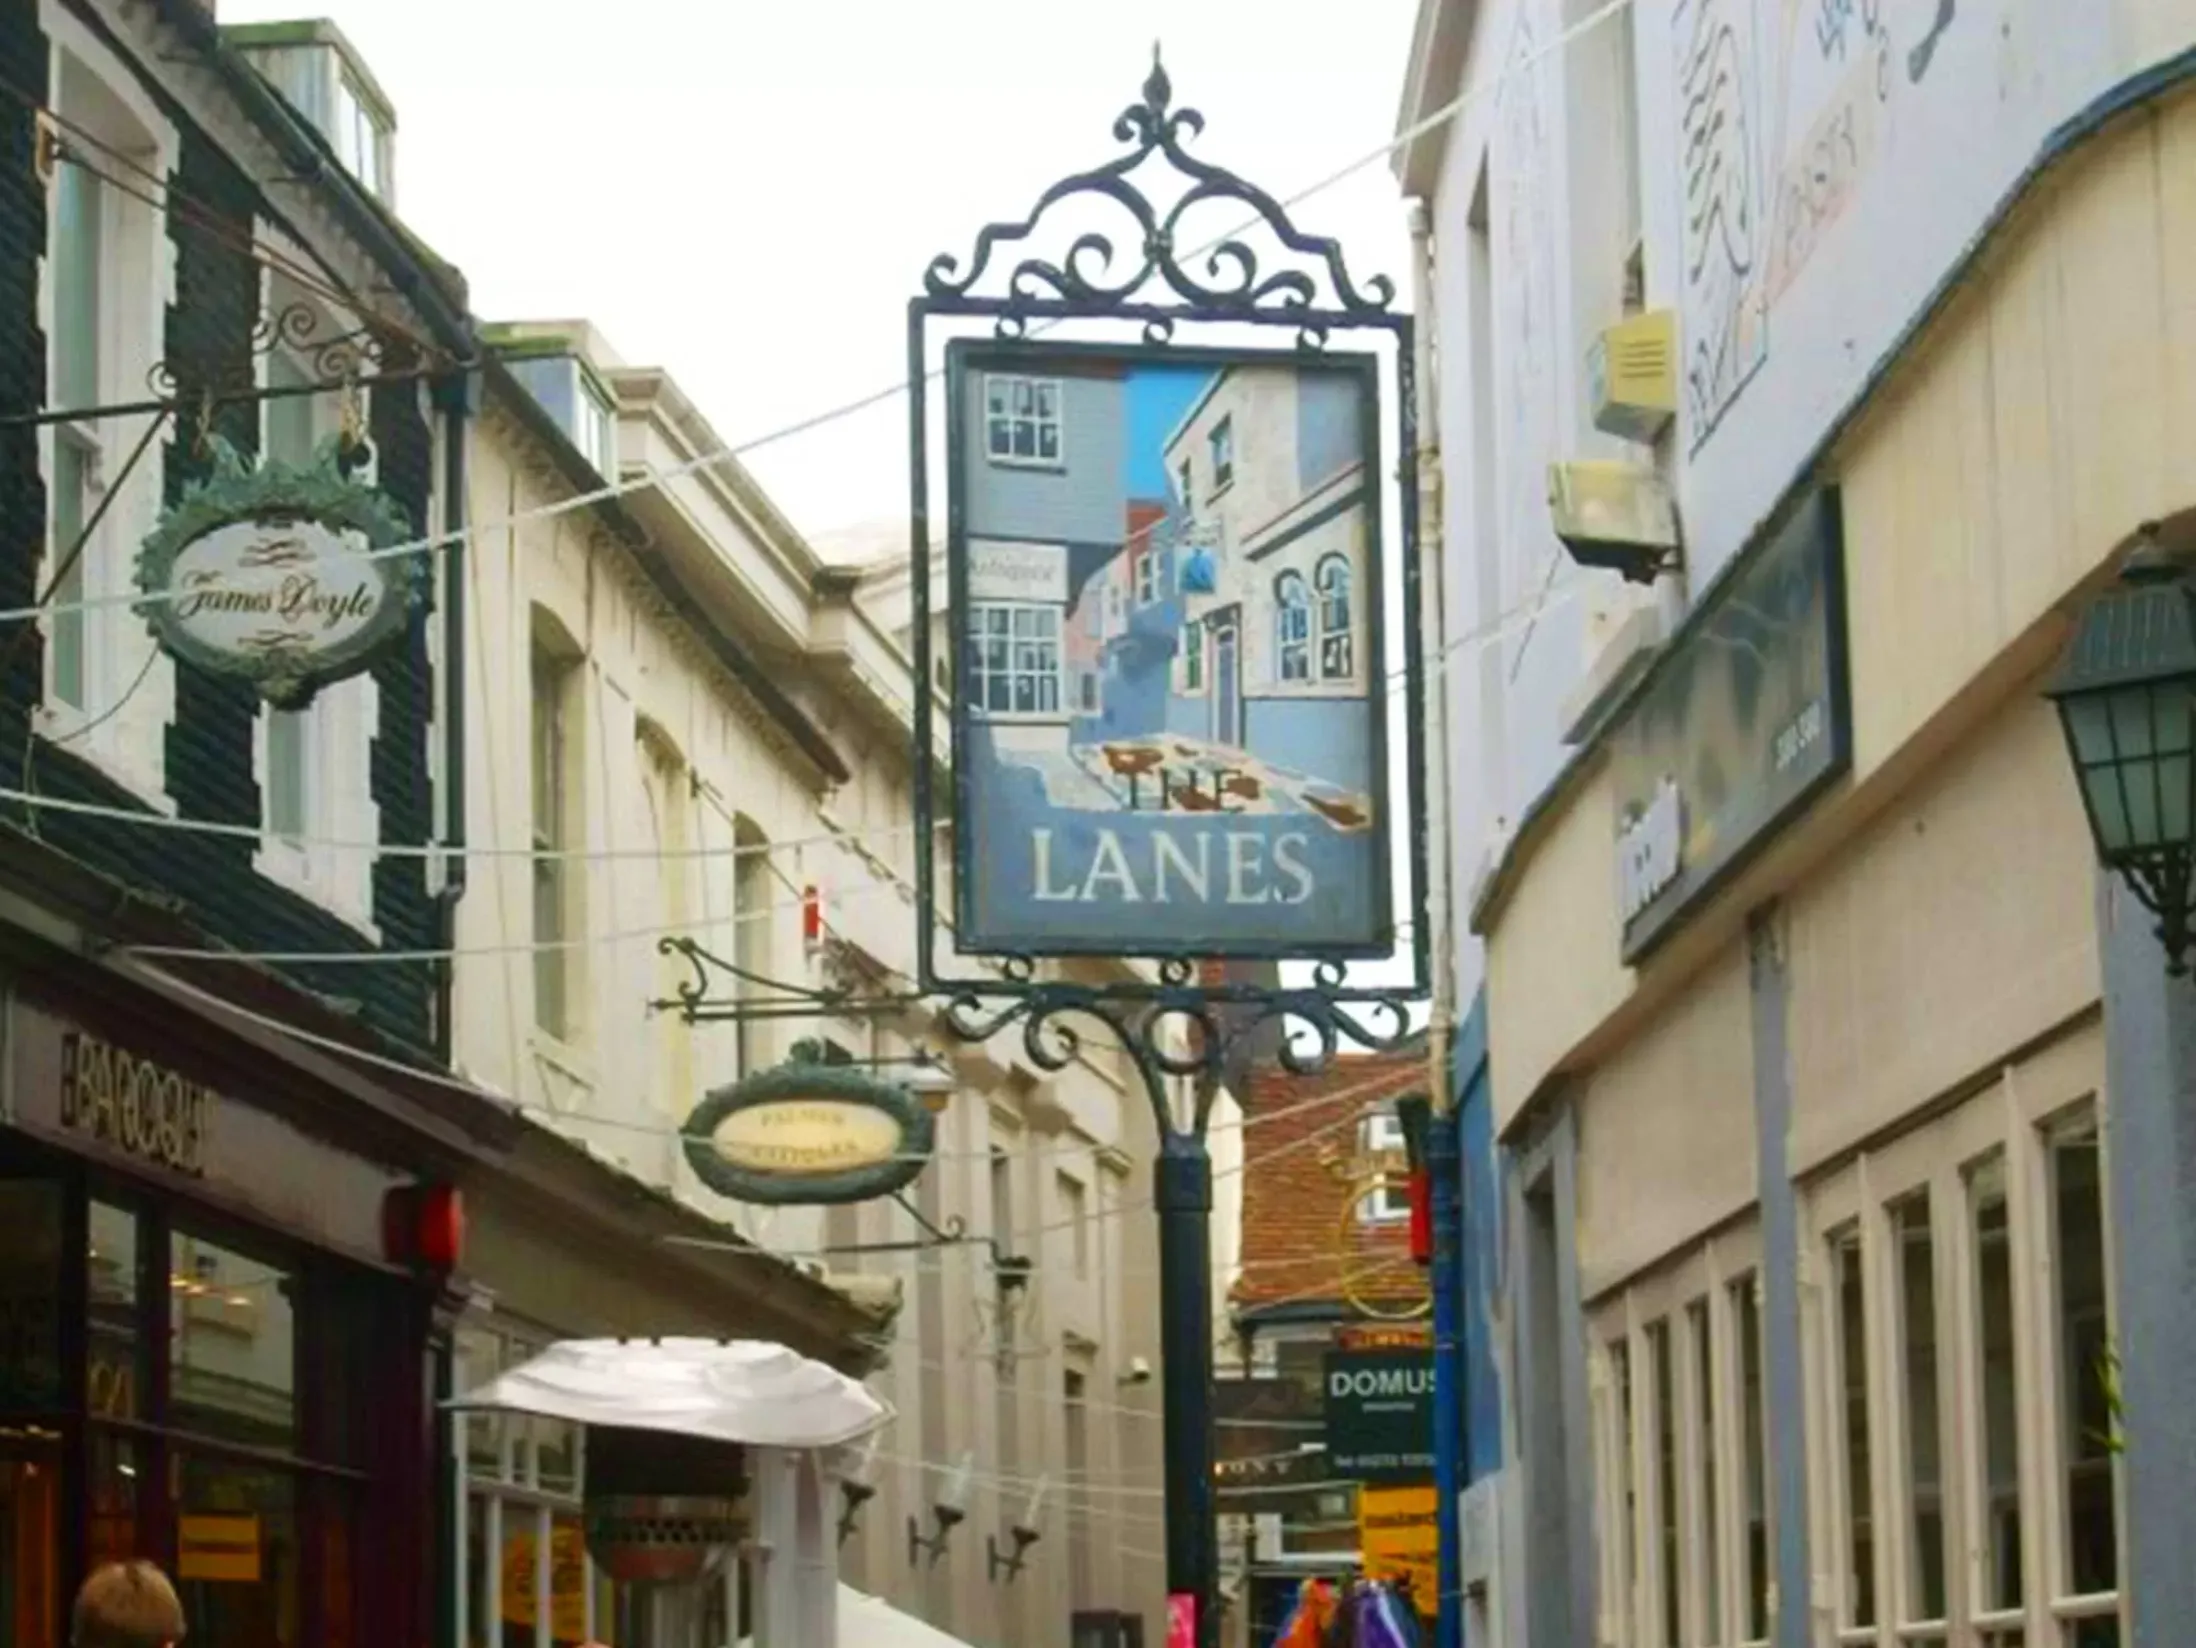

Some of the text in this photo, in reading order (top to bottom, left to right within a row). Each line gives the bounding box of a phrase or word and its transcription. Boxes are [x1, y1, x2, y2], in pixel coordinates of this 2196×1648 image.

[178, 569, 374, 630] James Doyle
[1115, 768, 1244, 811] THE
[1030, 828, 1314, 904] LANES
